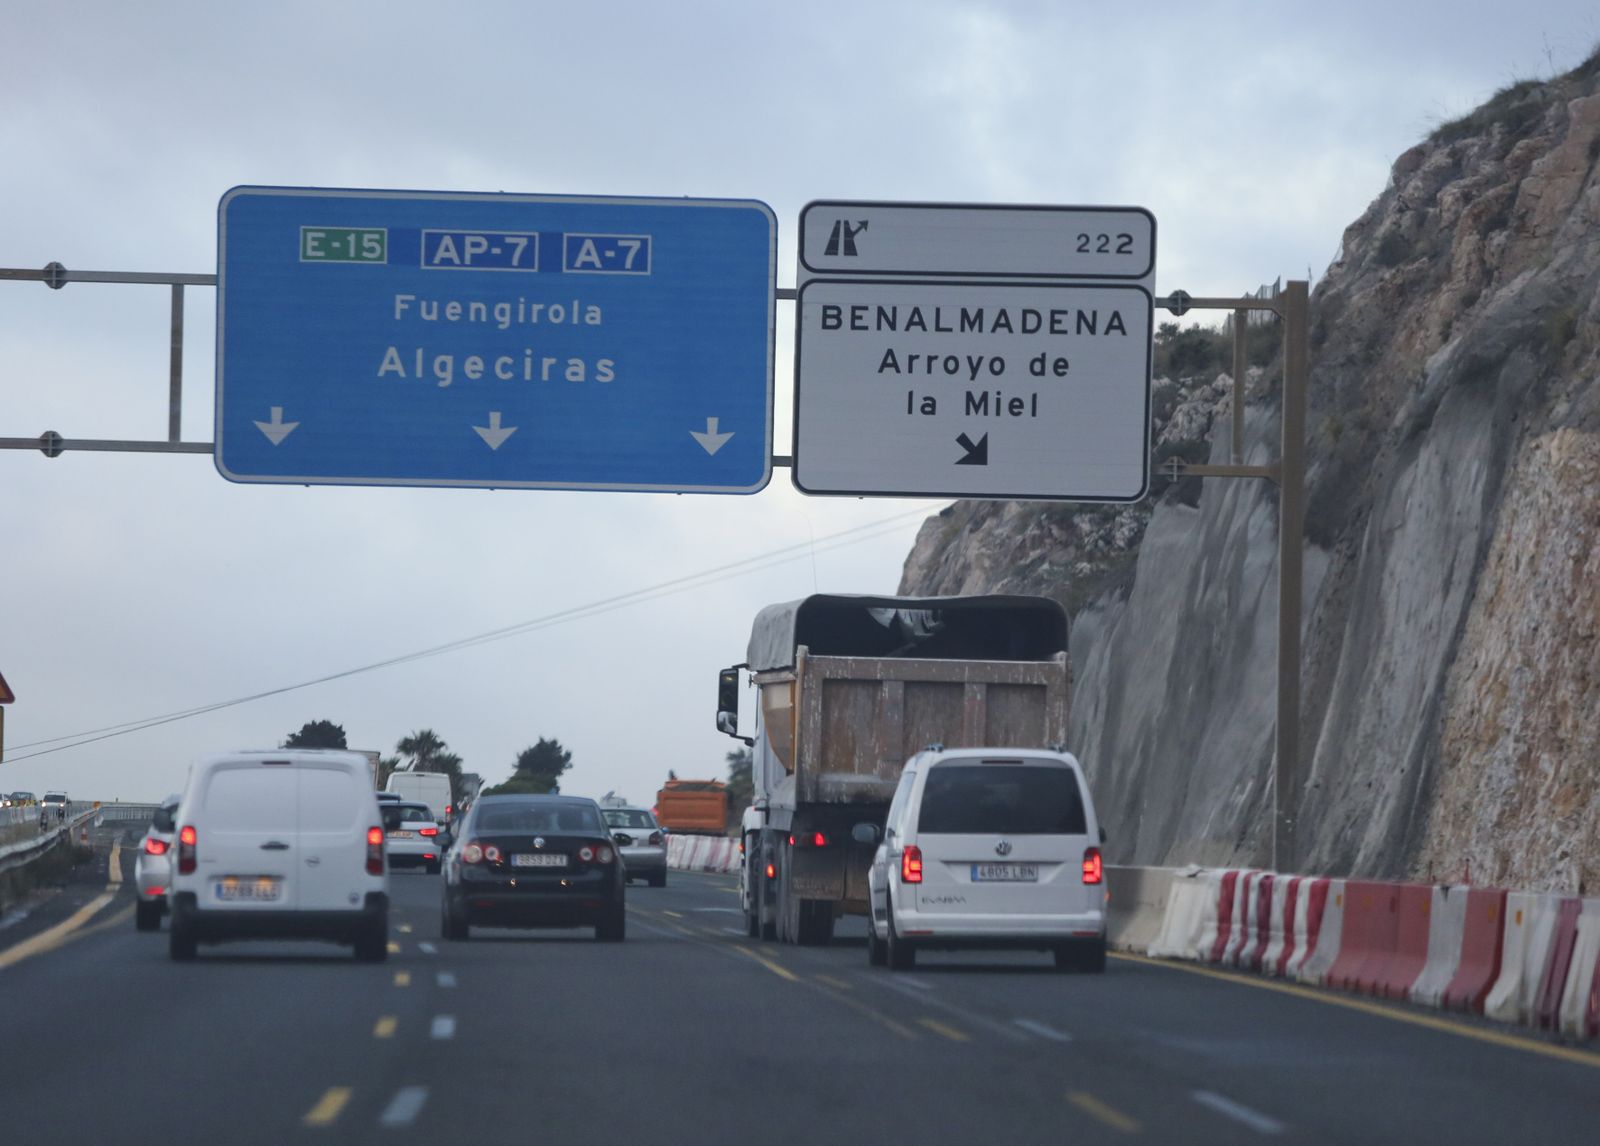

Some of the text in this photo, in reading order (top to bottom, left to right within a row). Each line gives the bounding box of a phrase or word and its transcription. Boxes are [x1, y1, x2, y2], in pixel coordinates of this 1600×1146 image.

[306, 232, 382, 259] E-15
[433, 235, 528, 267] AP-7
[574, 239, 642, 269] A-7
[1076, 233, 1134, 255] 222
[394, 294, 602, 329] Fuengirola
[821, 305, 1128, 336] BENALMADENA
[377, 346, 616, 387] Algeciras
[878, 348, 1070, 380] Arroyo de
[907, 390, 1039, 417] la Miel
